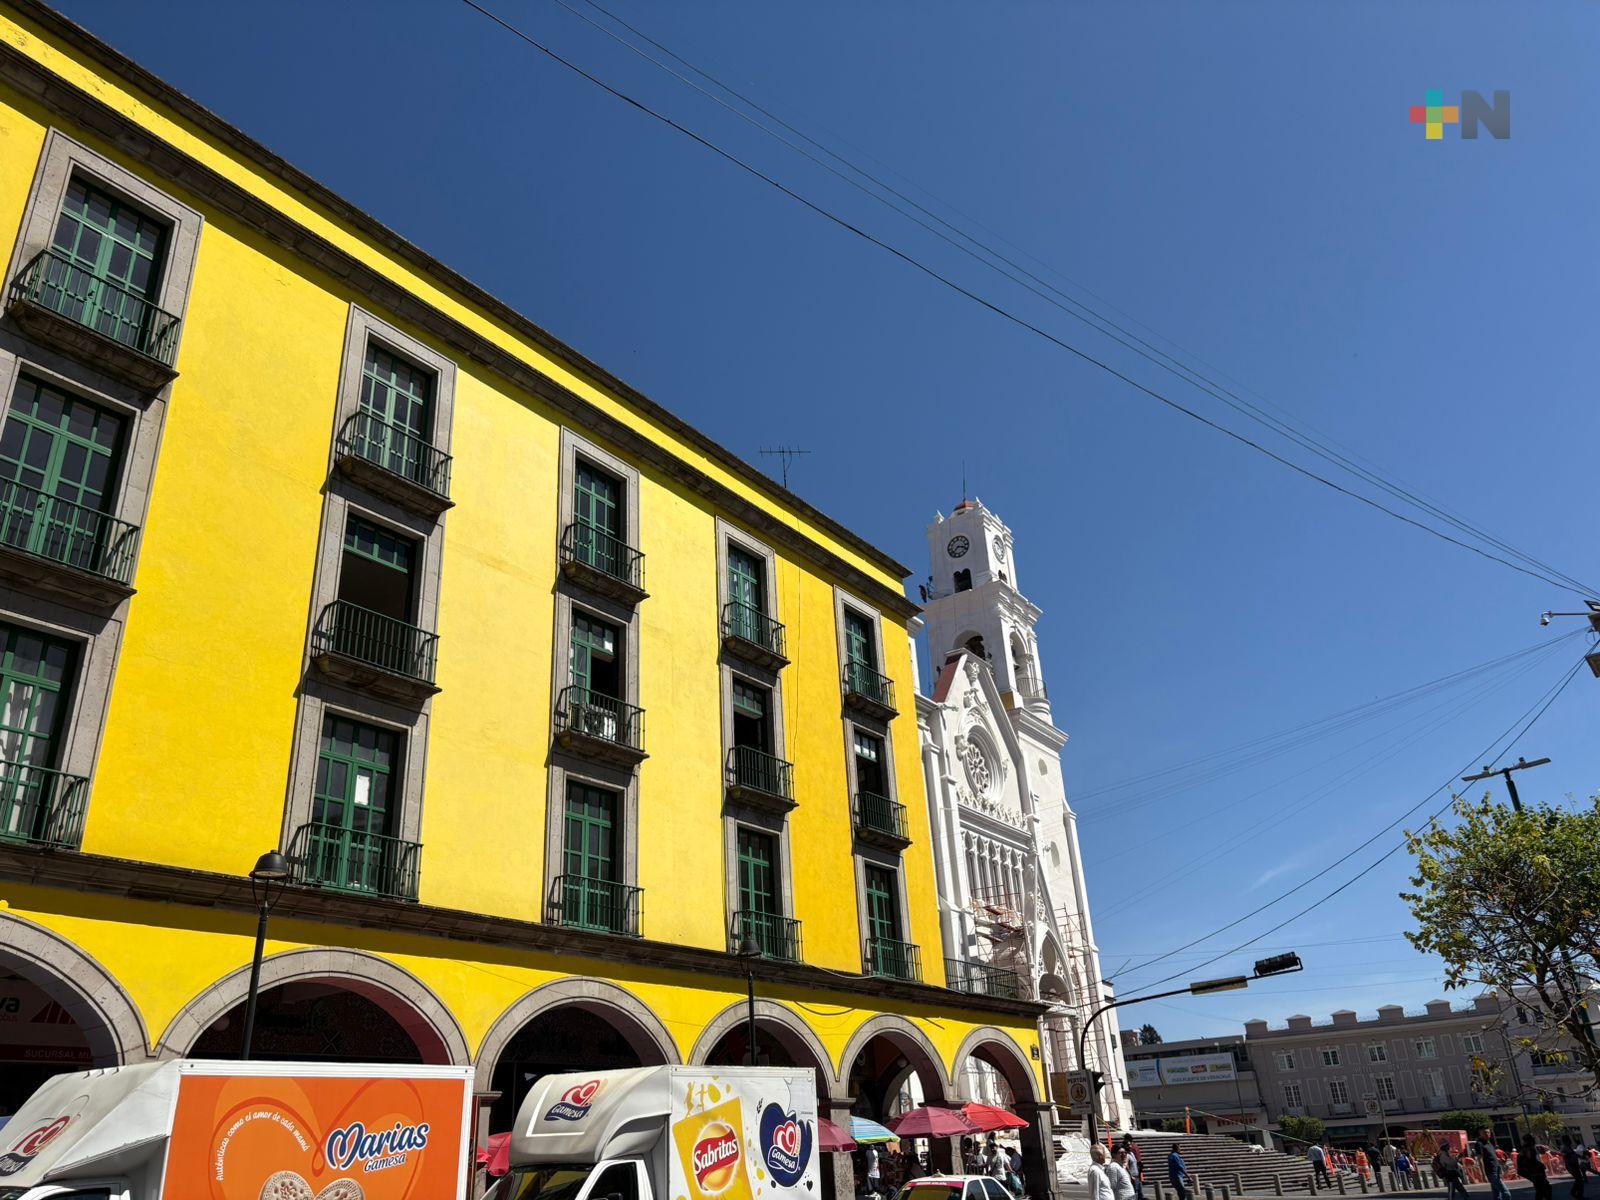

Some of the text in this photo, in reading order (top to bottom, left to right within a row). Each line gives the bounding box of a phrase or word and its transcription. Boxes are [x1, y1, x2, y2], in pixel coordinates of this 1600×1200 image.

[24, 1048, 74, 1058] SUCURSAL
[551, 1104, 584, 1118] Gamesa
[215, 1111, 310, 1181] Auténticas como el amor de cada mamá
[364, 1153, 408, 1173] Gamesa
[693, 1139, 738, 1175] Sabritas
[771, 1148, 796, 1169] Gamesa
